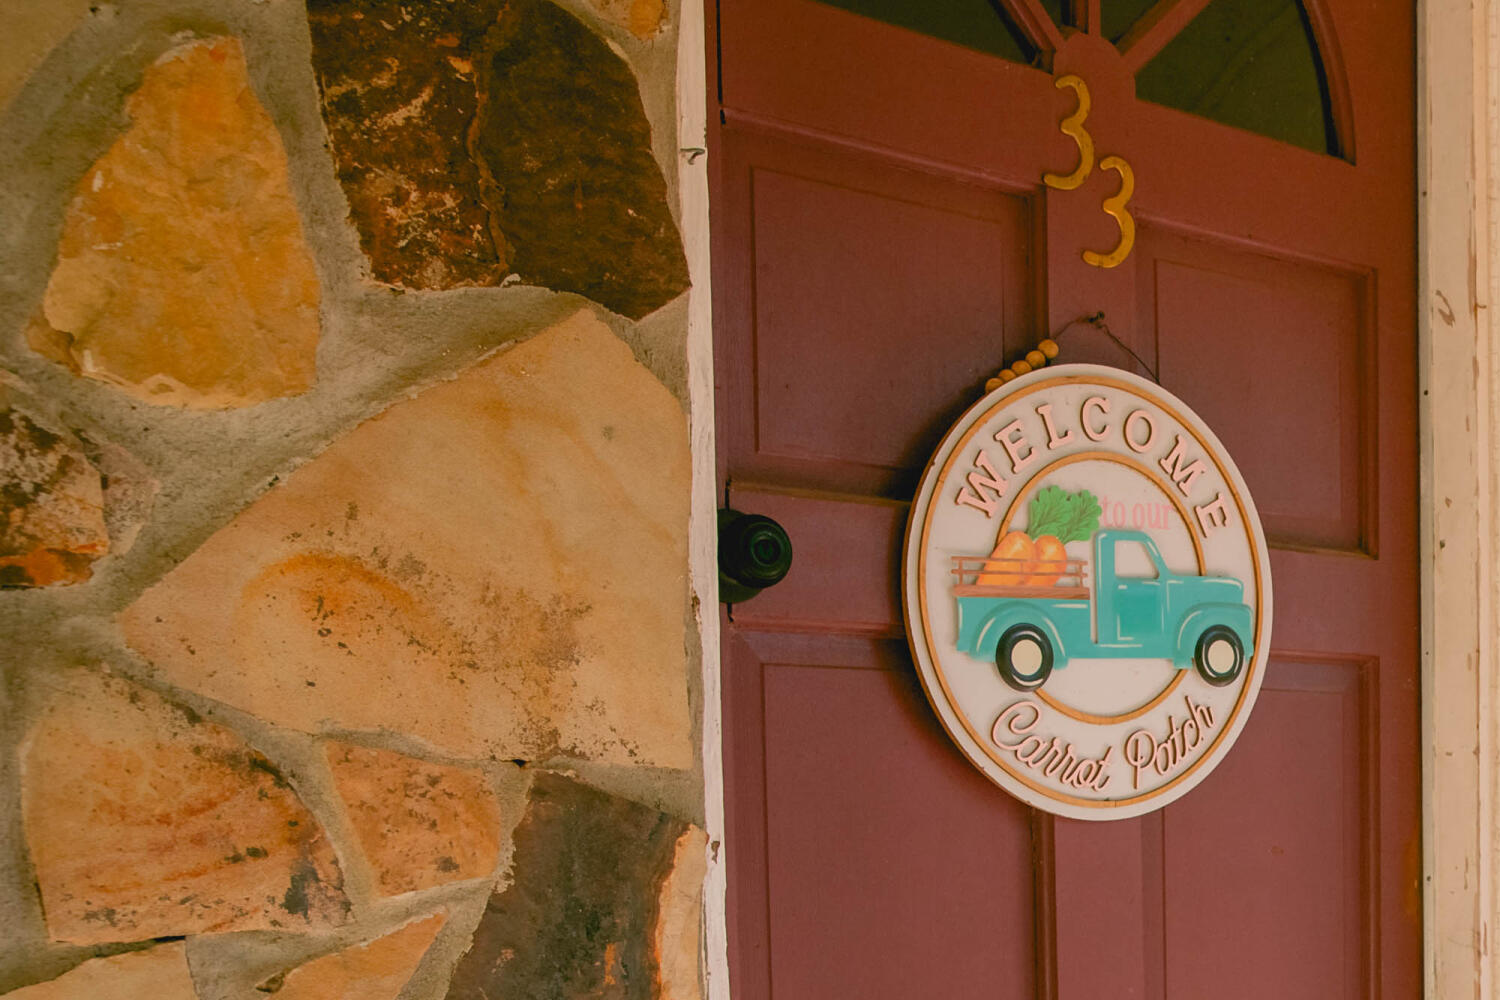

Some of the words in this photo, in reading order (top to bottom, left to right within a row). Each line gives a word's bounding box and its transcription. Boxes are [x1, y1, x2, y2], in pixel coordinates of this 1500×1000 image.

[955, 396, 1232, 538] WELCOME
[1101, 495, 1126, 528] to
[1131, 502, 1173, 530] our
[990, 700, 1114, 792] Carrot
[1124, 695, 1215, 790] Patch
